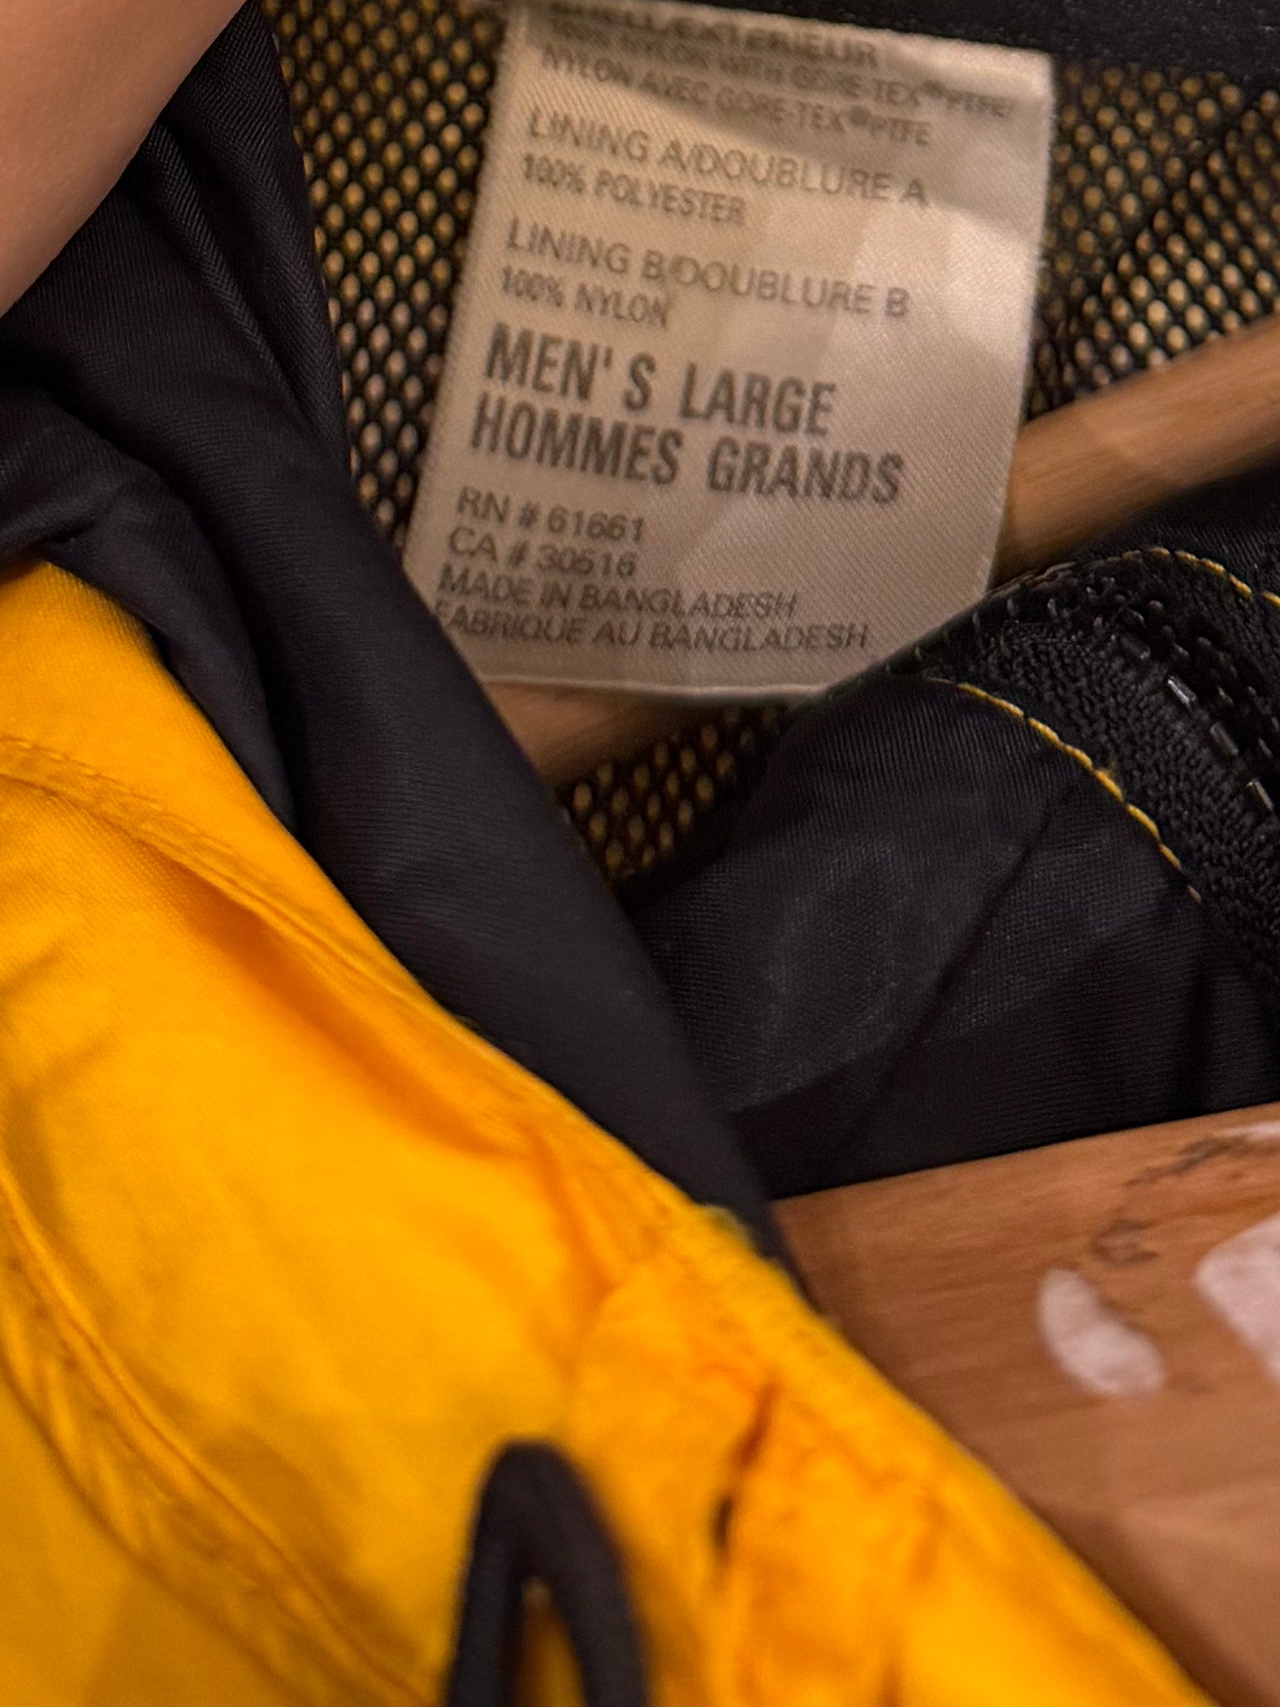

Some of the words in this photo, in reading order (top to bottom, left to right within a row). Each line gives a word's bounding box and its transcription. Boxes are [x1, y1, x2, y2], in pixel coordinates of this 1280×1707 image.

[540, 40, 633, 89] NYLON
[638, 67, 713, 109] AVEC
[522, 152, 586, 197] 100%
[593, 169, 746, 227] POLYESTER
[527, 106, 650, 163] LINING
[901, 174, 929, 213] A
[501, 264, 565, 309] 100%
[573, 281, 673, 330] NYLON
[506, 216, 631, 275] LINING
[883, 286, 911, 319] B
[677, 361, 838, 438] LARGE
[469, 390, 685, 486] HOMMES
[705, 433, 905, 506] GRANDS
[456, 486, 511, 524] RN
[518, 500, 543, 529] #
[547, 505, 645, 544] 61661
[448, 524, 499, 563] CA
[507, 538, 531, 568] #
[535, 543, 638, 580] 30516
[438, 561, 534, 607] MADE
[539, 580, 573, 609] IN
[577, 584, 798, 621] BANGLADESH
[590, 620, 642, 647] AU
[648, 619, 870, 652] BANGLADESH
